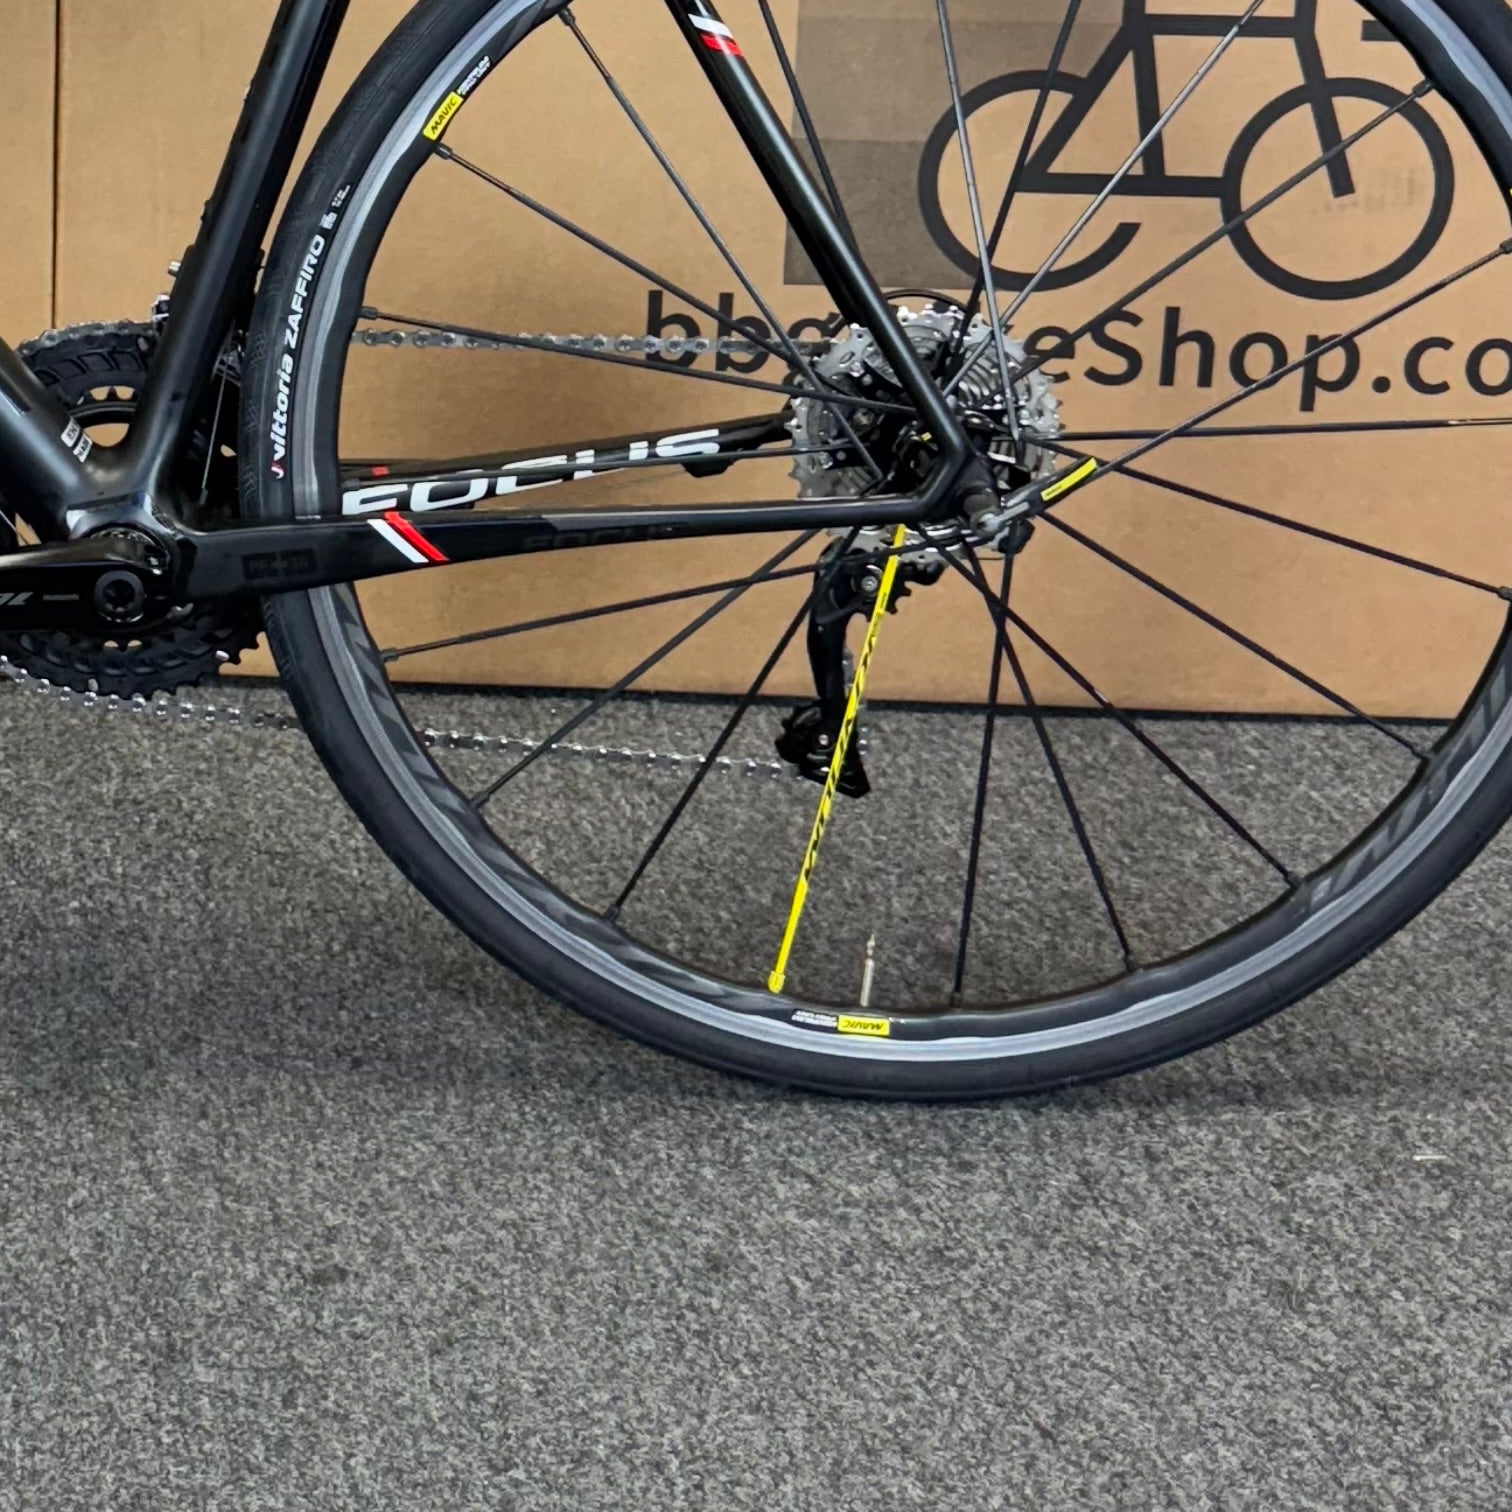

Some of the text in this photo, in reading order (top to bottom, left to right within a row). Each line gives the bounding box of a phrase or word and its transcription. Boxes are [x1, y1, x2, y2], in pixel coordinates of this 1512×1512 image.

[270, 234, 325, 461] vittoria ZAFFIRO
[342, 428, 720, 516] FOCUS
